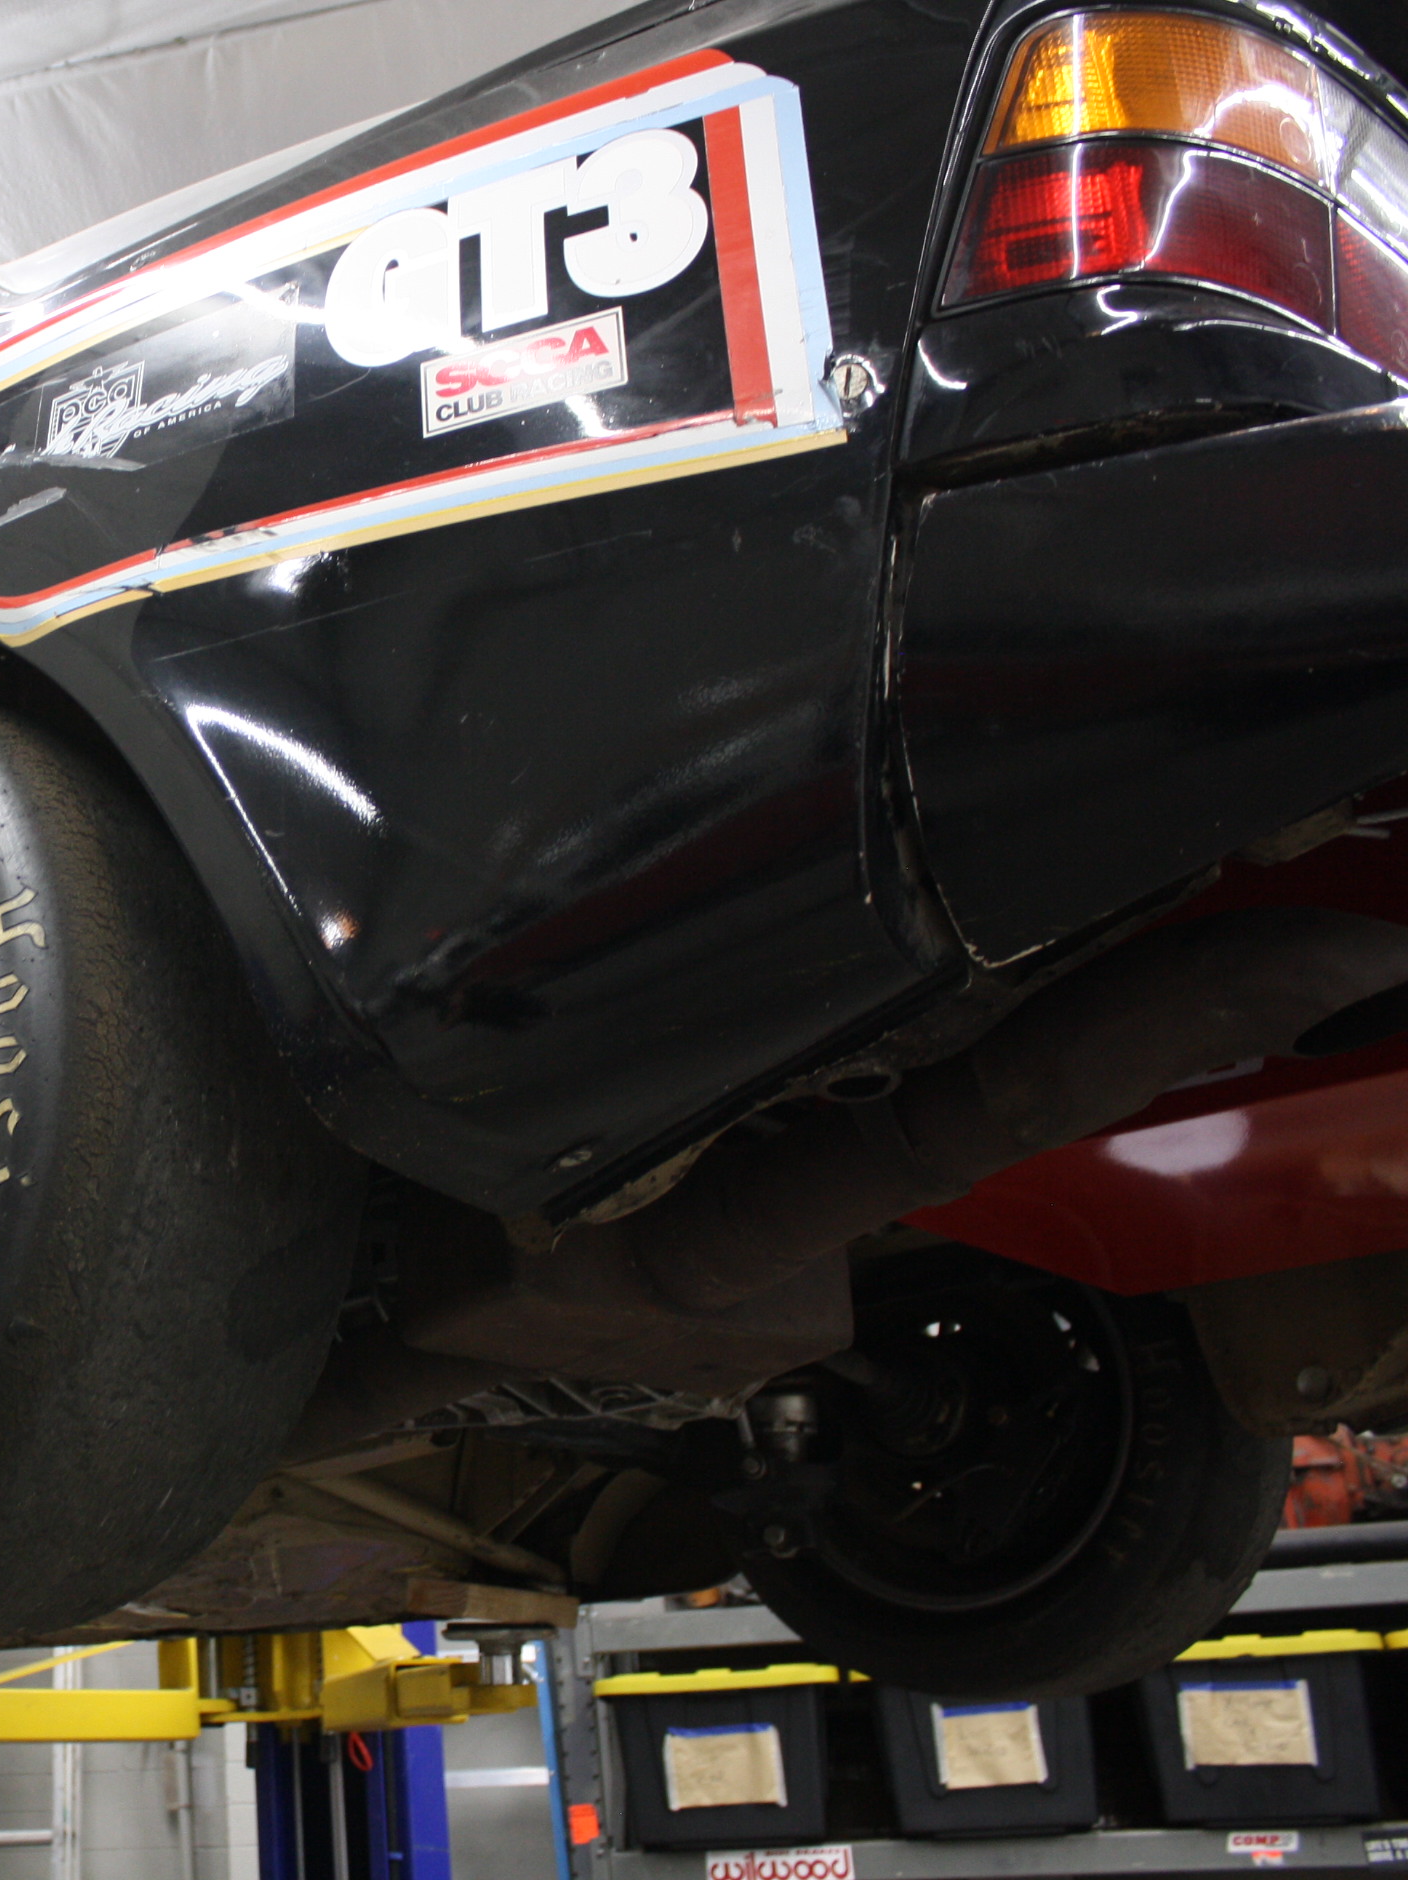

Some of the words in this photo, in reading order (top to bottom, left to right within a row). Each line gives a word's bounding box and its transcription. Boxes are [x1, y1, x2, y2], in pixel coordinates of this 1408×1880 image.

[324, 128, 709, 367] GT3
[435, 326, 610, 397] SCCA
[436, 389, 503, 422] CLUB
[510, 359, 614, 402] RACING
[70, 354, 290, 452] Racing
[133, 425, 151, 439] OF
[157, 401, 222, 428] AMERICA
[710, 1849, 851, 1880] wilwood
[1232, 1835, 1281, 1846] COMP
